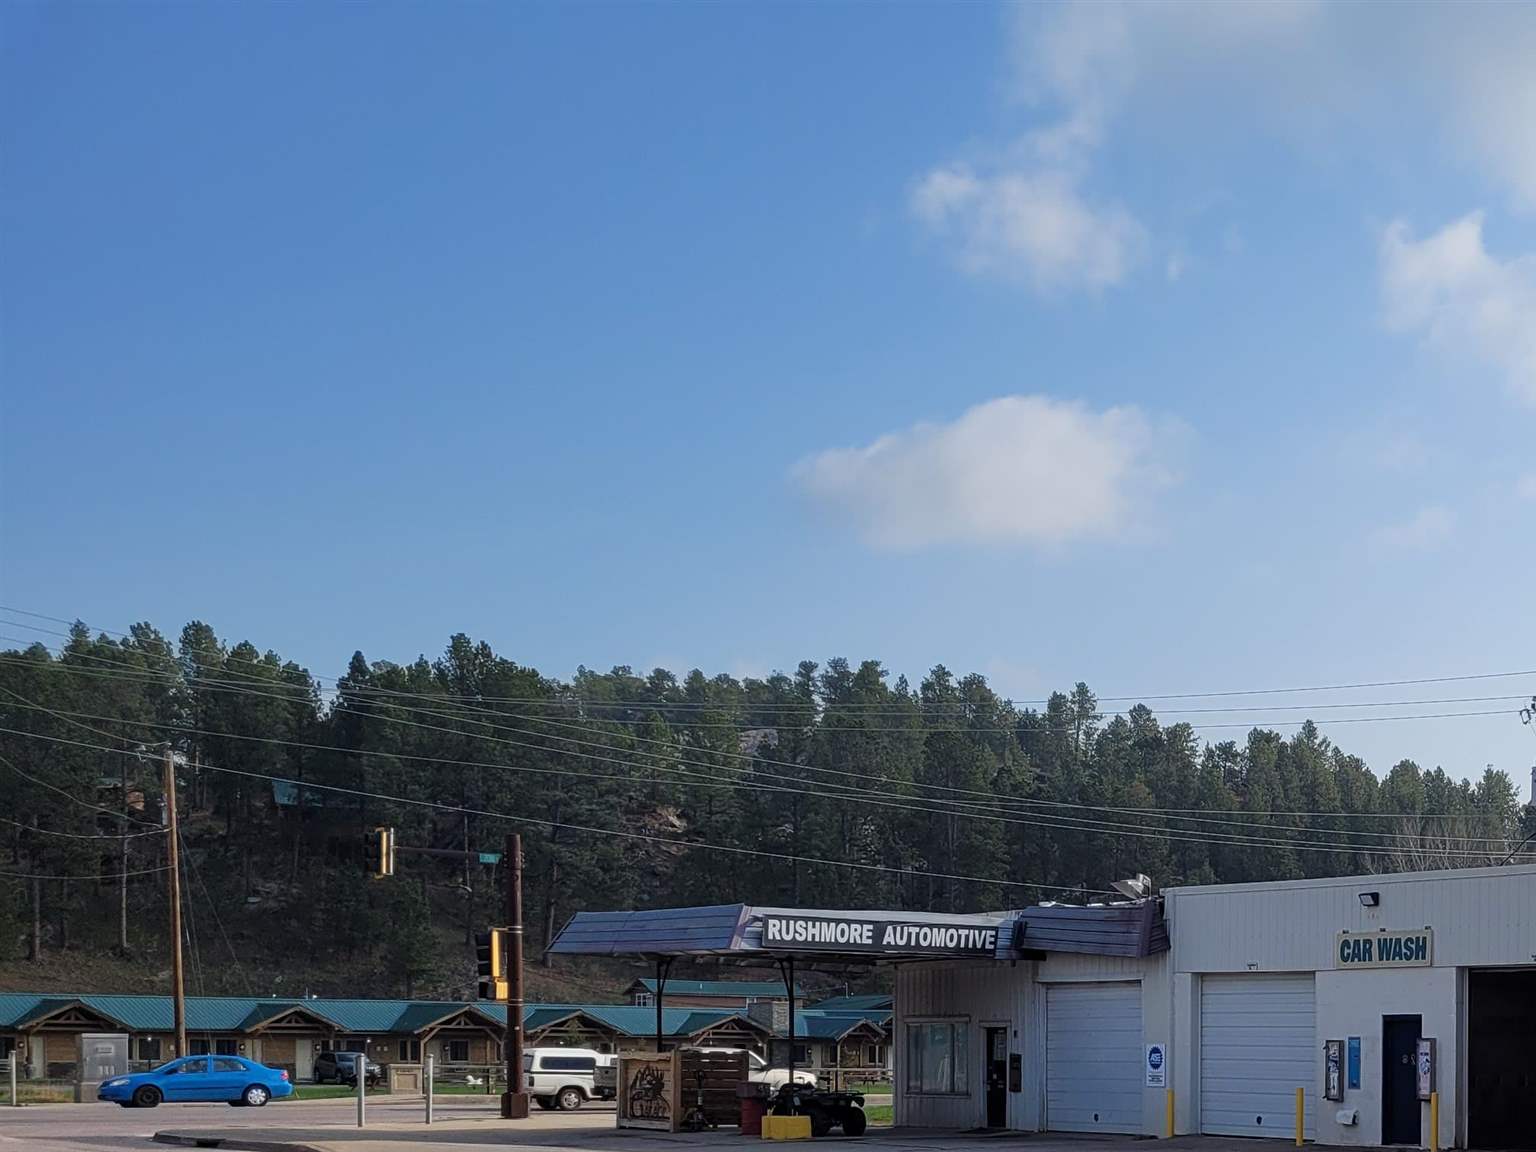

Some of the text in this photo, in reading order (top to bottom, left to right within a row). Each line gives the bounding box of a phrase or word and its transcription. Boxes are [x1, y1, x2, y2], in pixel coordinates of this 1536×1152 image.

[767, 919, 996, 949] RUSHMORE AUTOMOTIVE
[1340, 936, 1427, 962] CAR WASH
